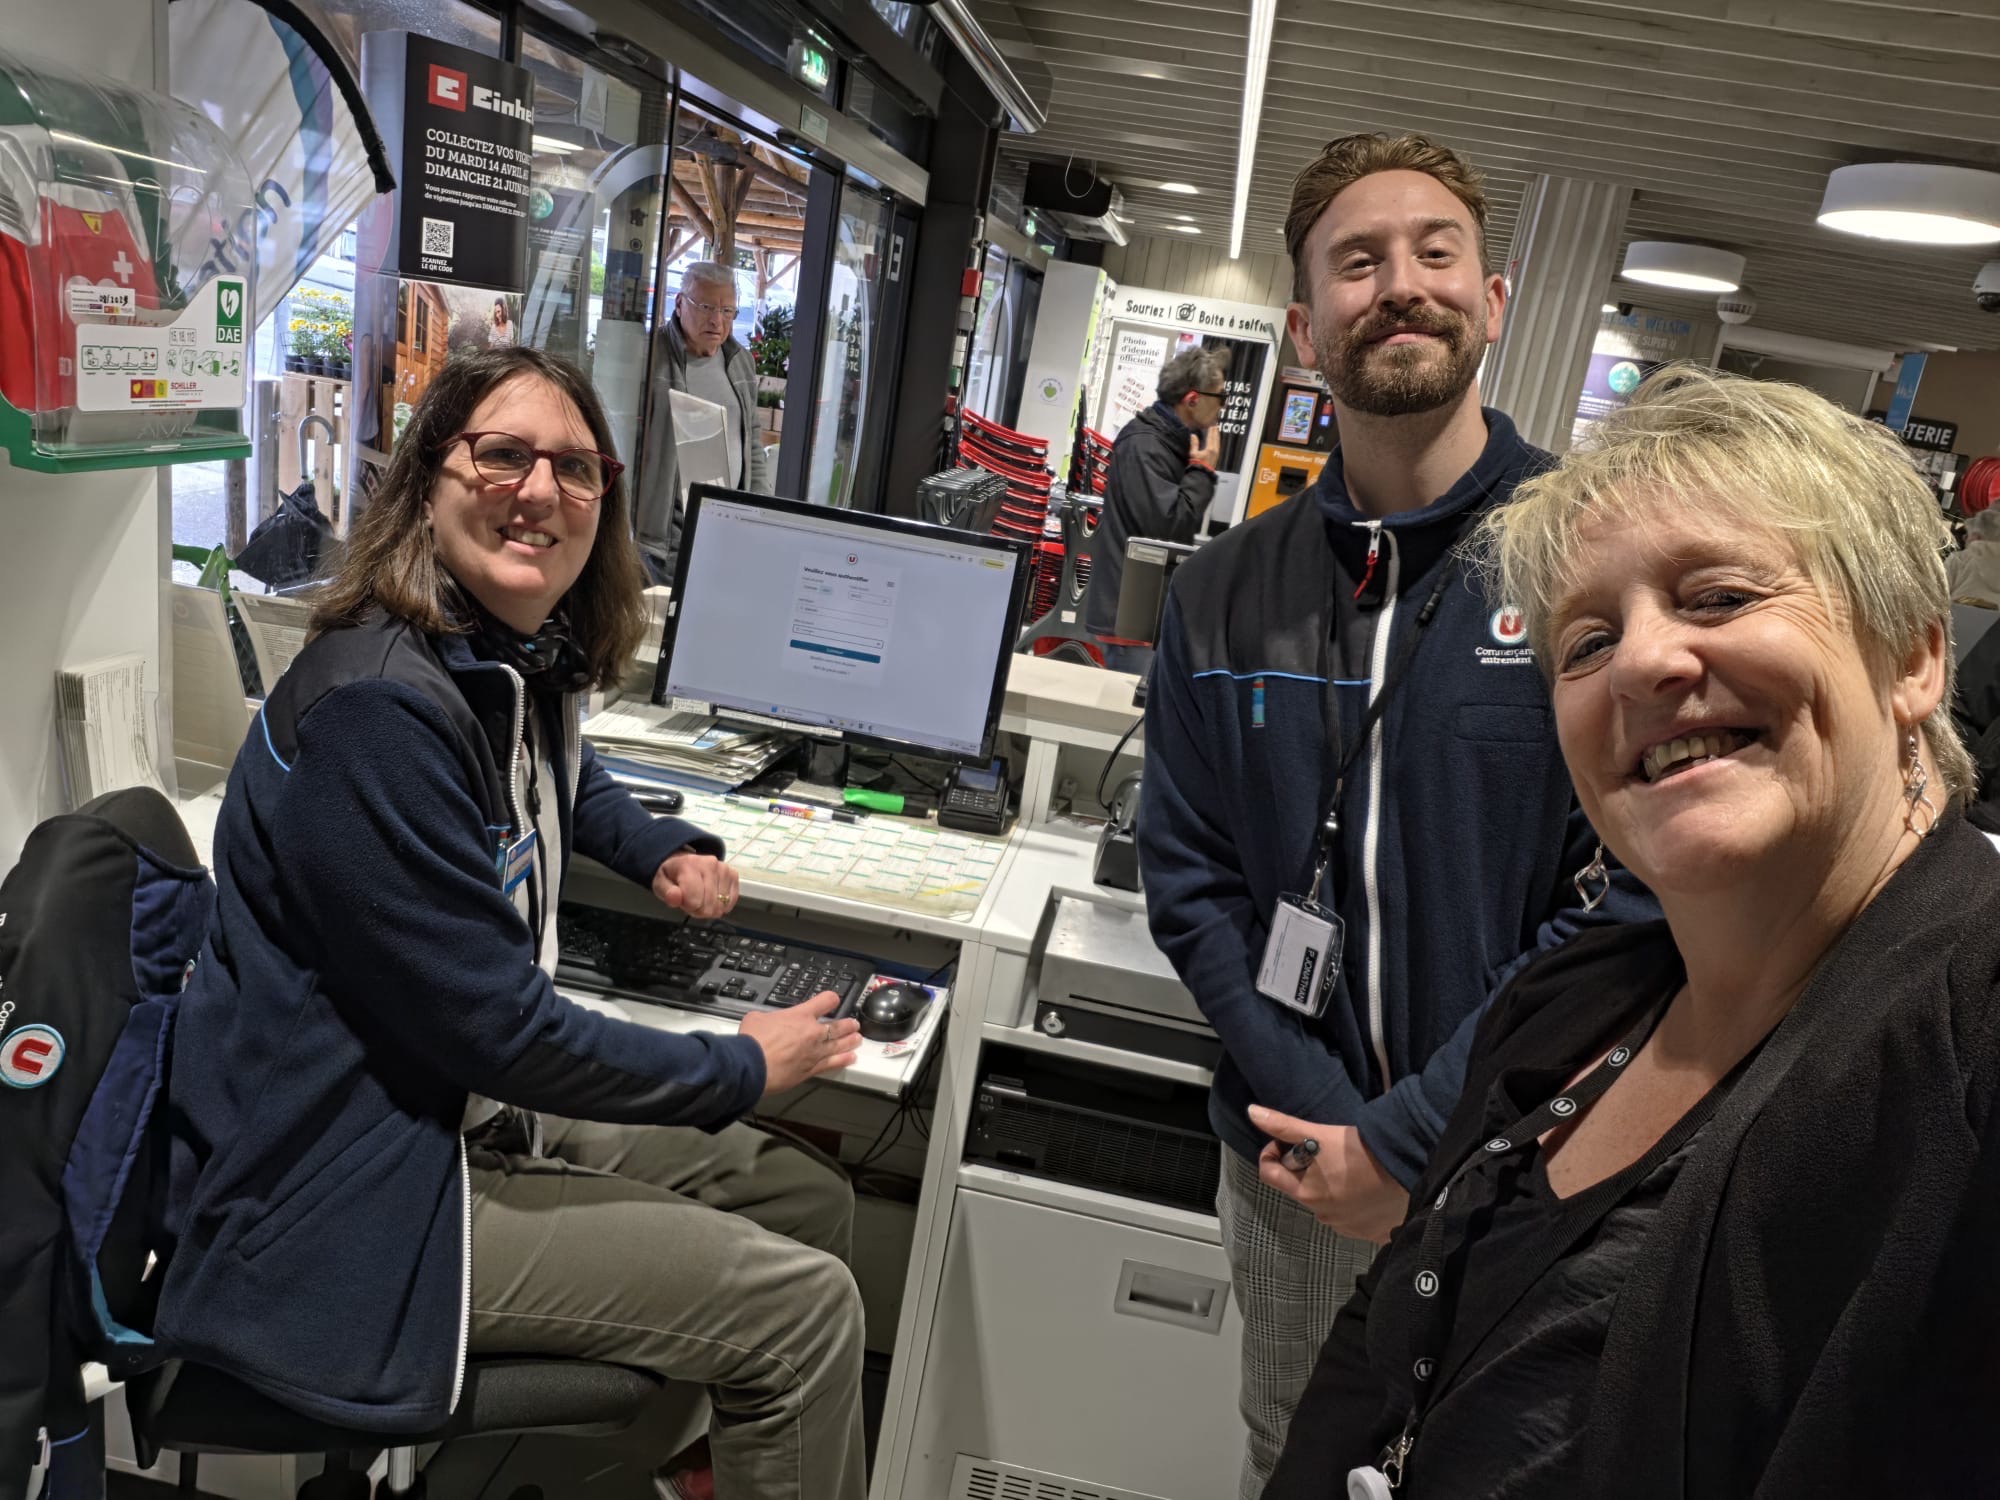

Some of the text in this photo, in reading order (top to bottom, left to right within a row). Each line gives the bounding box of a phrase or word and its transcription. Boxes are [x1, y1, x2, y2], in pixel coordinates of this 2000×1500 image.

[426, 128, 495, 155] COLLECTEZ
[496, 144, 514, 160] VOS
[426, 145, 445, 160] DU
[448, 150, 487, 170] MARDI
[489, 160, 499, 172] 14
[501, 163, 523, 178] AVRIL
[425, 162, 491, 187] DIMANCHE
[493, 177, 502, 190] 21
[504, 179, 521, 194] JUIN
[425, 183, 440, 193] Vous
[421, 256, 447, 266] SCANNEZ
[429, 263, 438, 271] QR
[438, 265, 453, 273] CODE
[1126, 299, 1165, 318] Souriez
[218, 327, 241, 342] DAE
[1123, 335, 1147, 346] Photo
[1121, 345, 1160, 357] d'identité
[1119, 354, 1155, 366] officielle
[171, 382, 197, 390] SCHILLER
[11, 1038, 53, 1075] U
